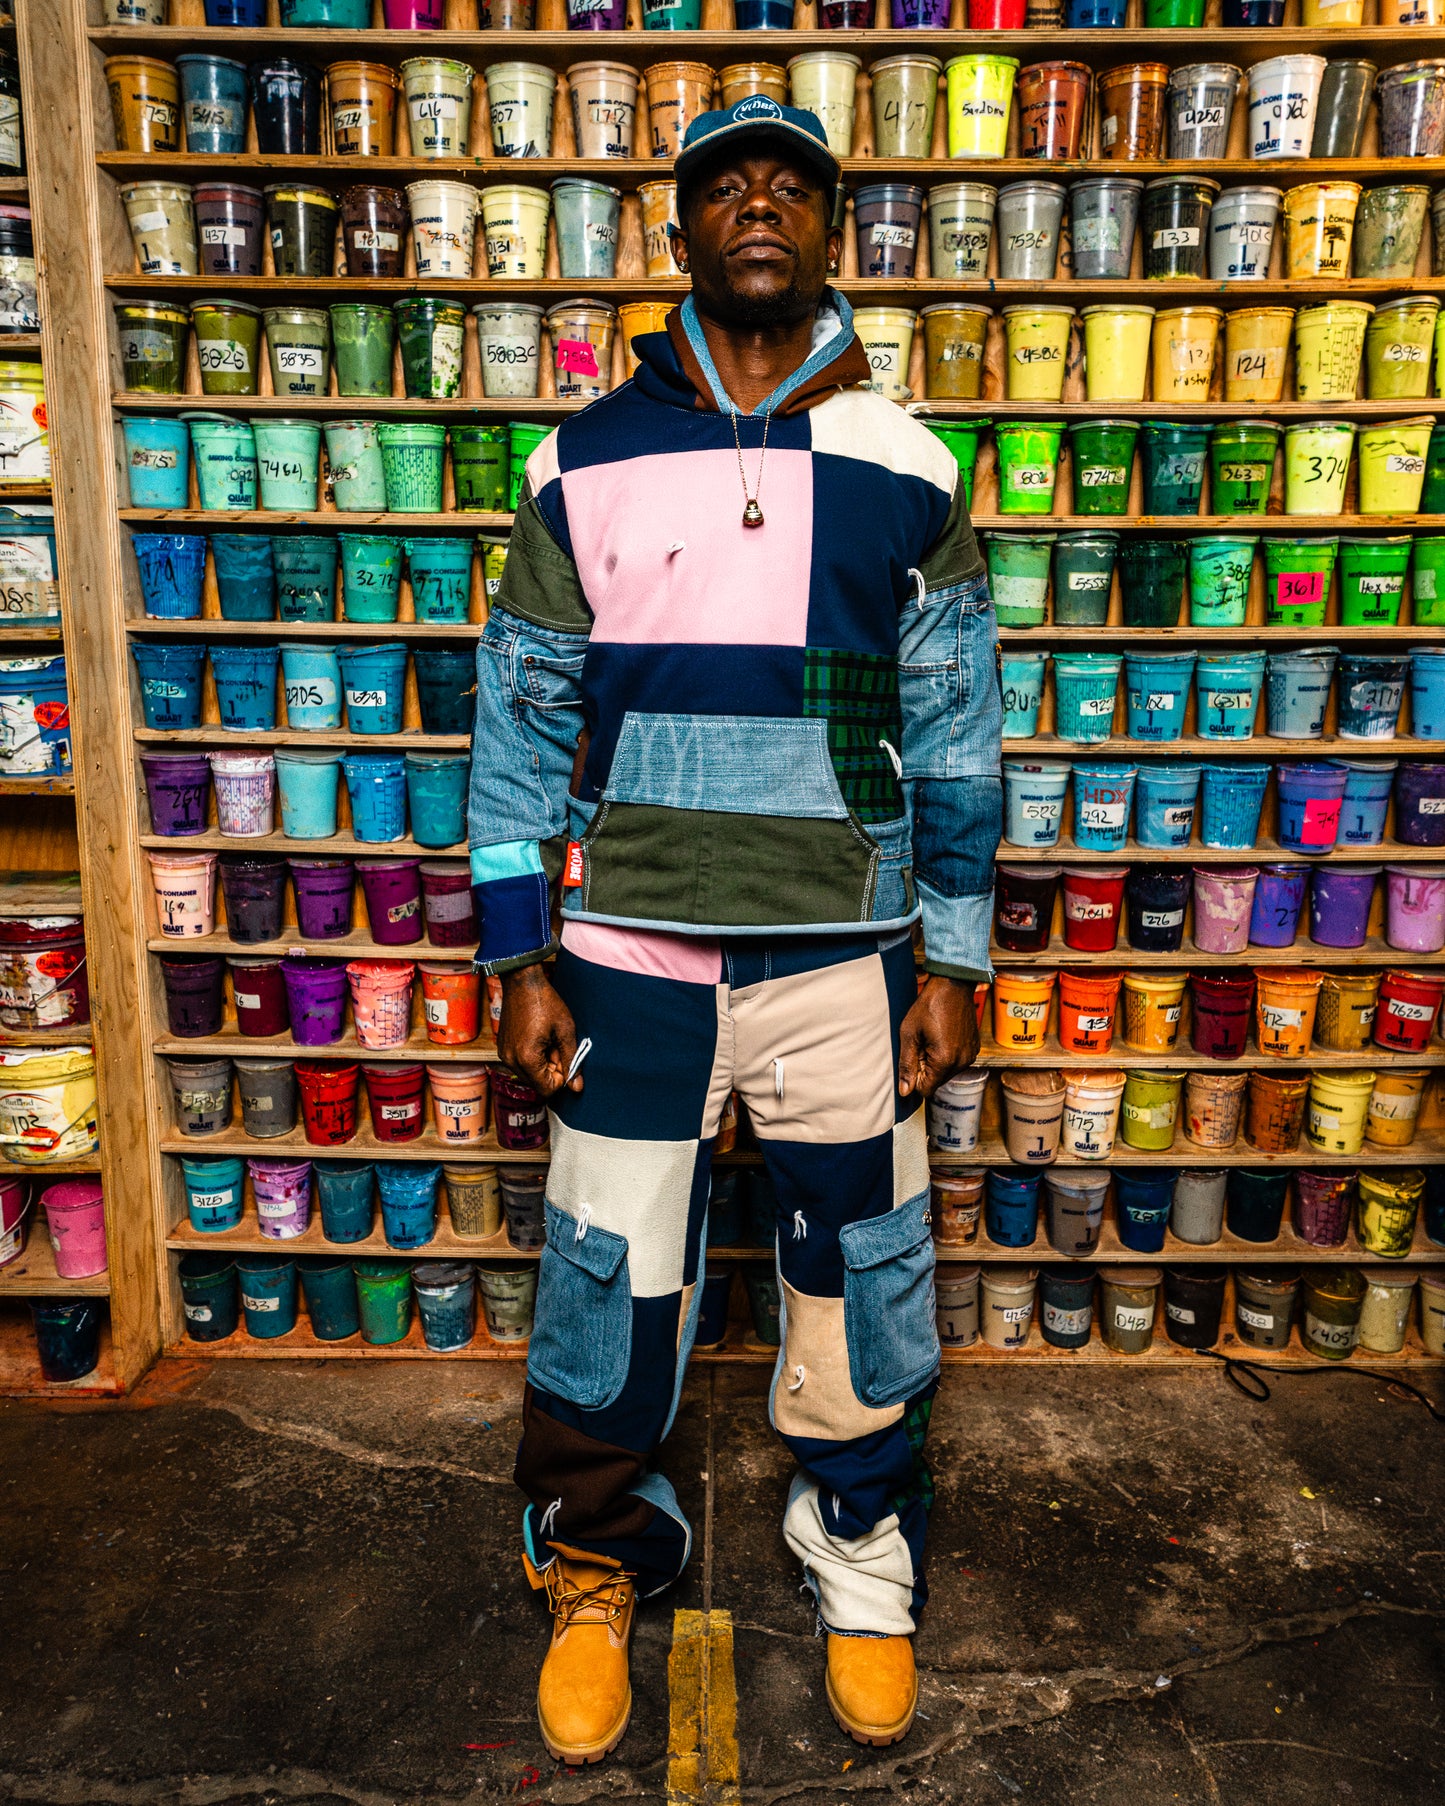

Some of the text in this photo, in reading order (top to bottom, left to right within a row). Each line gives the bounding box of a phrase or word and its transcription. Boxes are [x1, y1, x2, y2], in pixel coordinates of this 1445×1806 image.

[117, 4, 146, 17] QUART
[192, 107, 225, 125] 5415
[420, 102, 440, 118] 616
[615, 125, 621, 144] 1
[653, 127, 659, 145] 1
[1263, 121, 1270, 139] 1
[424, 137, 450, 146] QUART
[1255, 140, 1280, 151] QUART
[205, 230, 226, 243] 437
[1161, 231, 1189, 246] 133
[416, 242, 422, 259] 1
[1328, 241, 1334, 258] 1
[280, 352, 316, 368] 5835
[1236, 356, 1266, 378] 124
[289, 383, 315, 392] QUART
[560, 383, 581, 393] QUART
[1305, 457, 1347, 490] 374
[467, 480, 473, 496] 1
[229, 493, 252, 502] QUART
[1283, 576, 1316, 597] 361
[1362, 609, 1389, 618] QUART
[286, 687, 323, 706] 2905
[163, 700, 169, 714] 1
[230, 700, 235, 717] 1
[1218, 709, 1224, 724] 1
[1137, 725, 1163, 734] QUART
[1209, 725, 1235, 734] QUART
[1084, 787, 1129, 805] HDX
[1357, 816, 1363, 830] 1
[1346, 831, 1371, 839] QUART
[163, 889, 197, 897] CONTAINER
[332, 908, 338, 923] 1
[1147, 914, 1170, 926] 276
[162, 924, 184, 933] QUART
[1022, 1020, 1027, 1035] 1
[1398, 1021, 1404, 1035] 1
[1012, 1034, 1036, 1042] QUART
[1073, 1038, 1098, 1047] QUART
[445, 1106, 472, 1117] 1565
[454, 1117, 460, 1131] 1
[446, 1130, 470, 1138] QUART
[1037, 1137, 1044, 1150] 1
[1075, 1142, 1099, 1151] QUART
[1027, 1150, 1051, 1158] QUART
[202, 1217, 227, 1225] QUART
